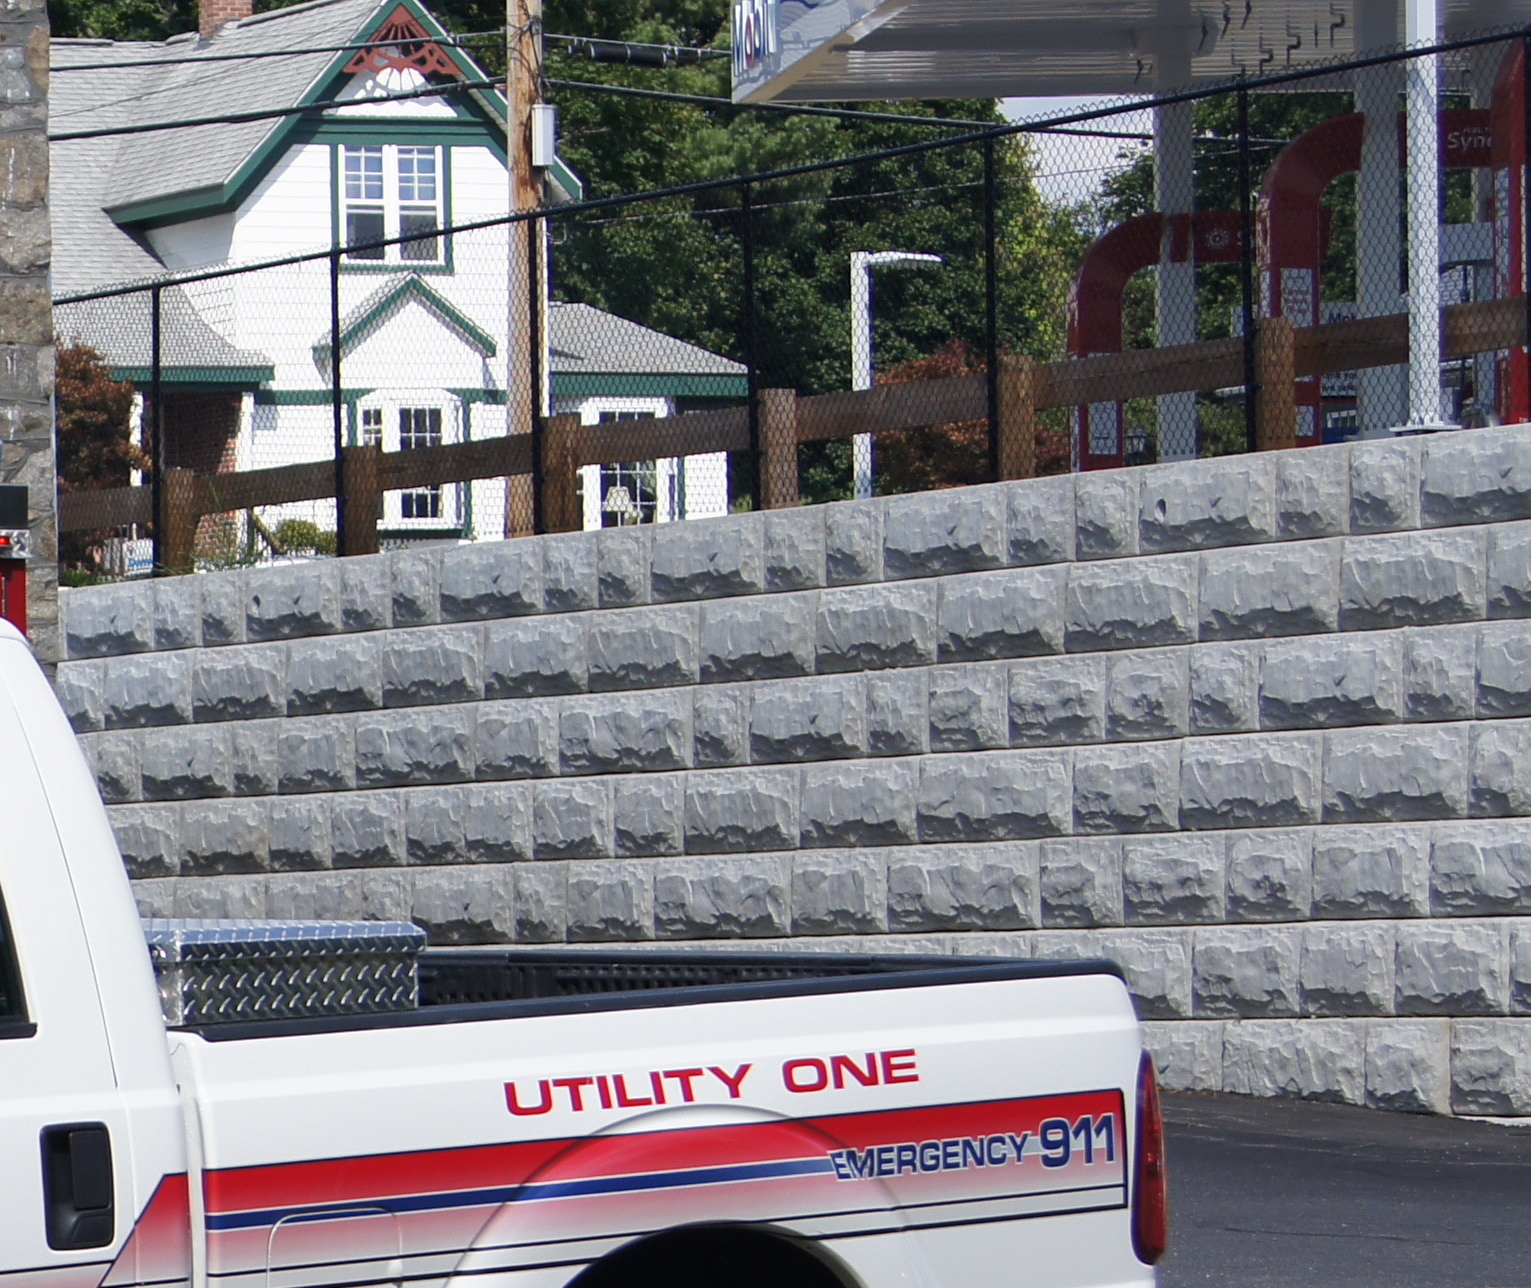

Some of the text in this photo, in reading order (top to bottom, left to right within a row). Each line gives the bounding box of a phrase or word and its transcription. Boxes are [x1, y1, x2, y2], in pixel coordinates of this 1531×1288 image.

[503, 1048, 920, 1116] UTILITY ONE
[828, 1112, 1117, 1181] EMERGENCY 911
